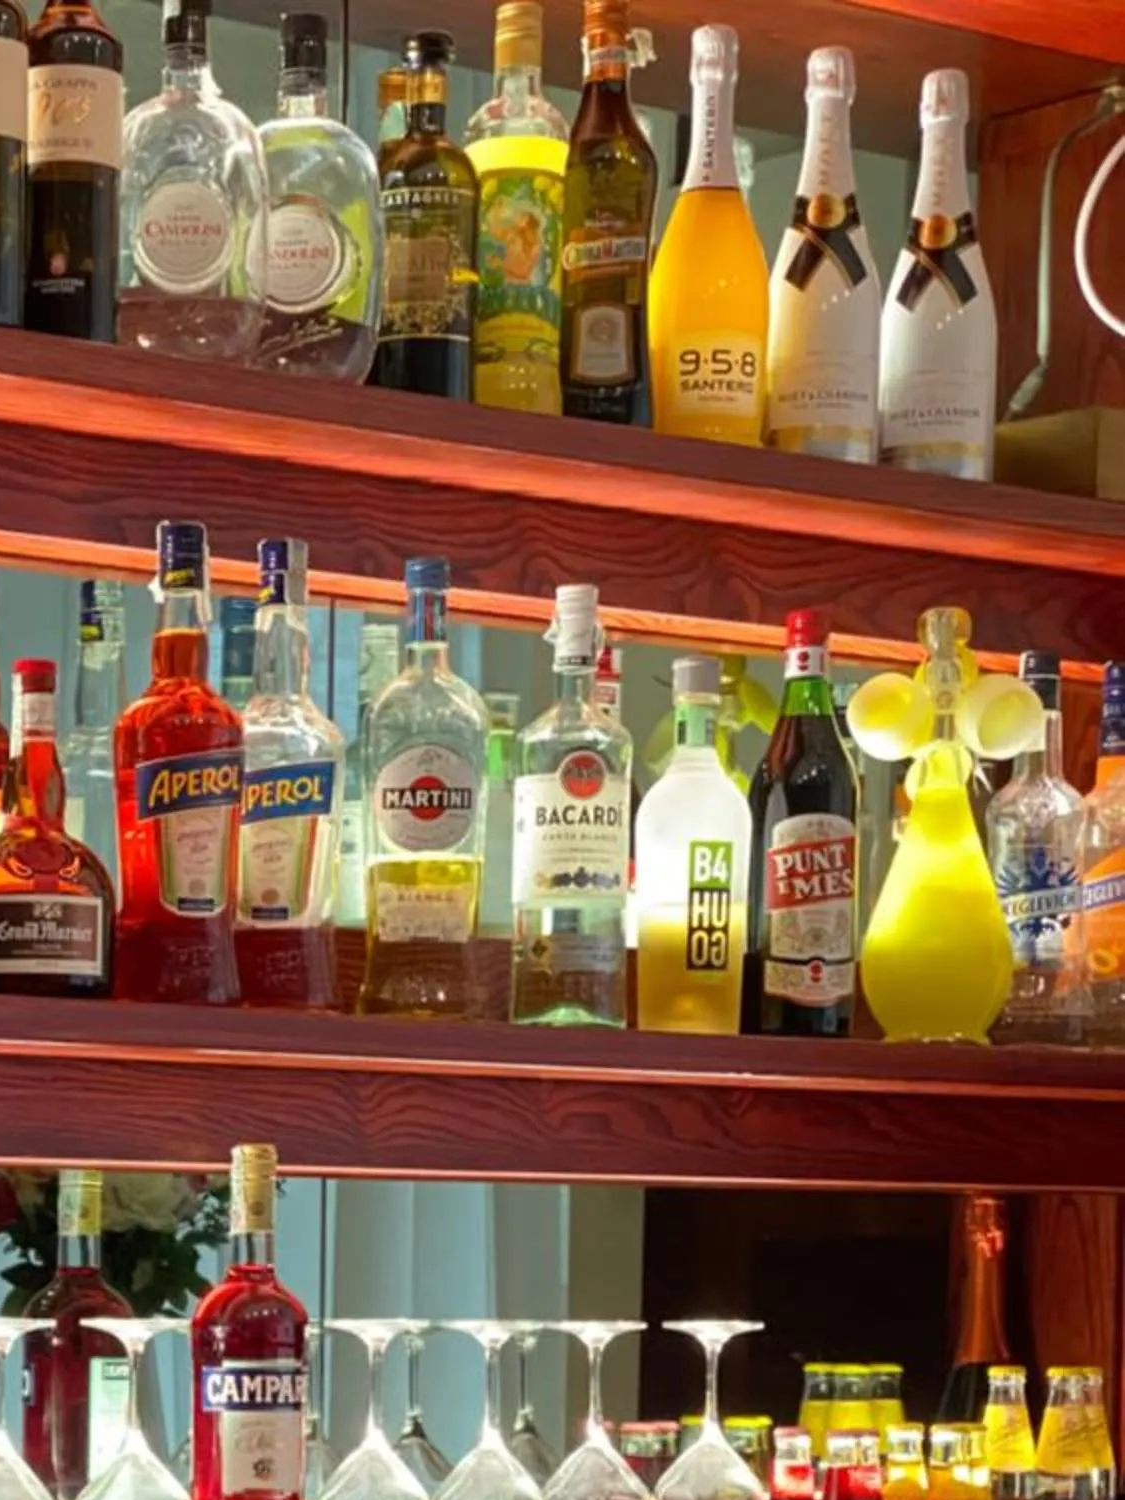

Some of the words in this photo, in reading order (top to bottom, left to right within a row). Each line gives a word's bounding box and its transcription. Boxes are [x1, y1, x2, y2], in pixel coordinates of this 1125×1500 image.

[680, 379, 755, 395] SANTERO
[148, 764, 240, 809] APEROL
[386, 788, 471, 808] MARTINI
[693, 846, 729, 884] B4
[772, 842, 847, 880] PUNT
[791, 867, 855, 900] MES
[691, 891, 728, 928] HU
